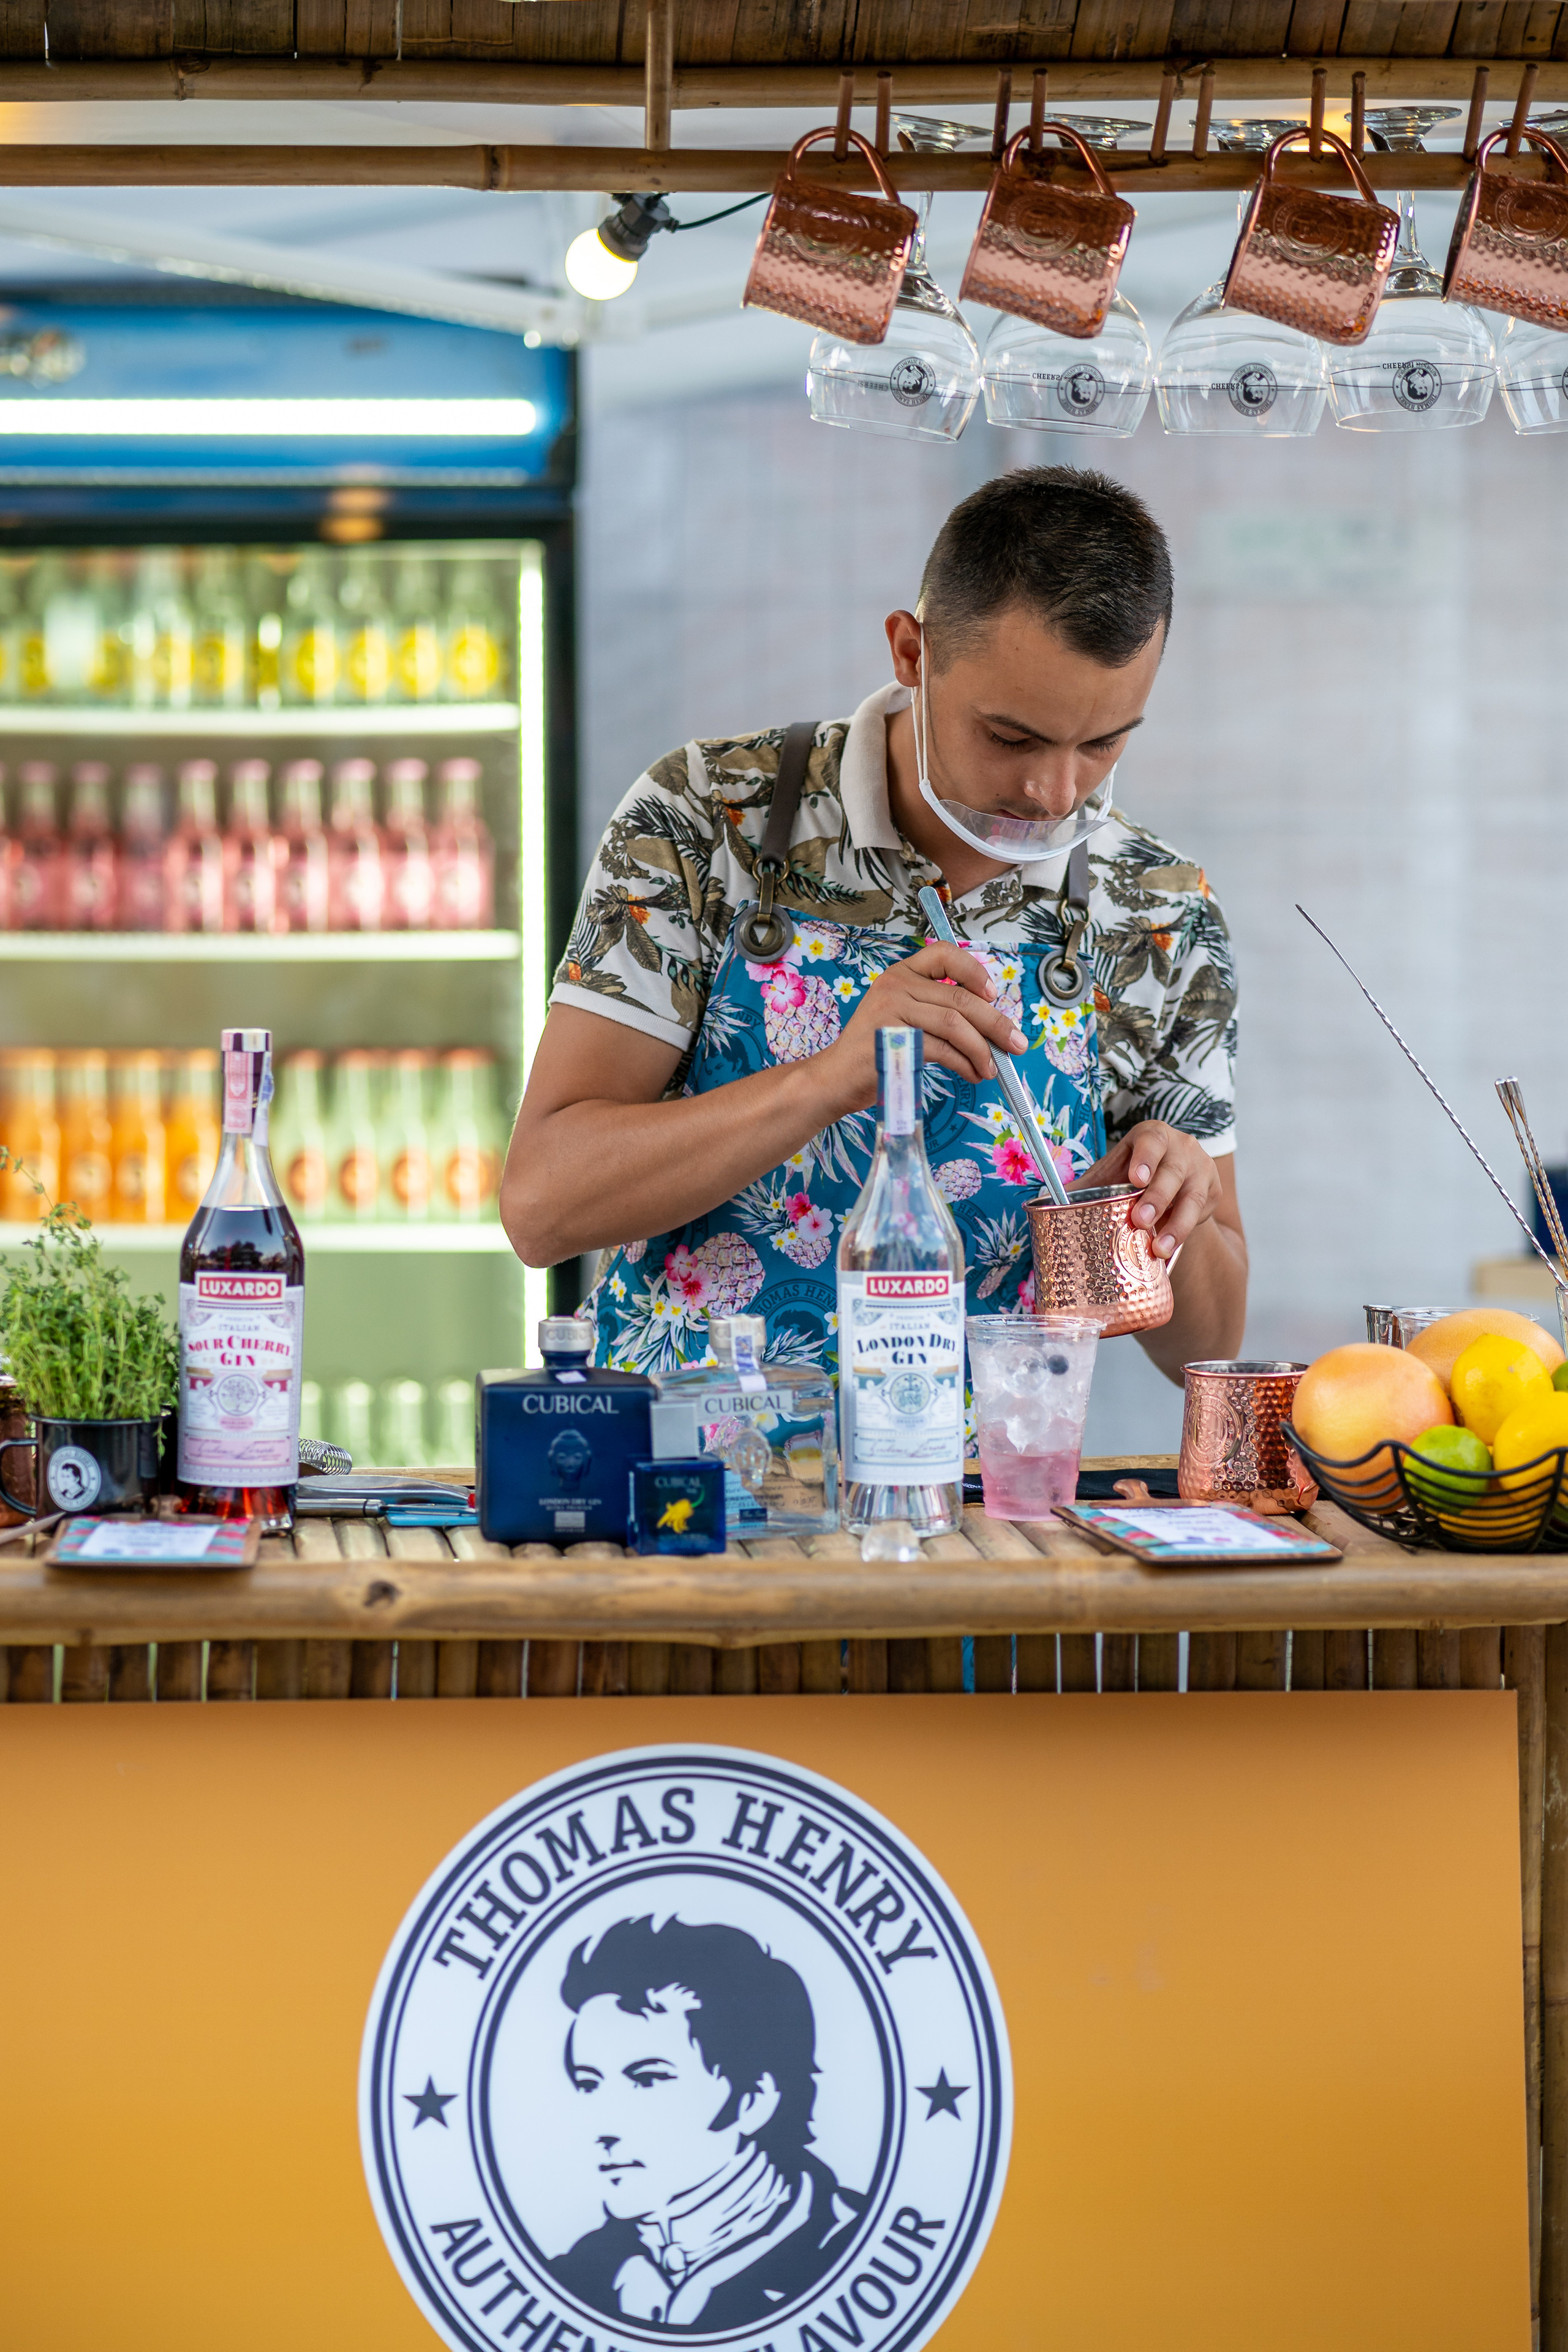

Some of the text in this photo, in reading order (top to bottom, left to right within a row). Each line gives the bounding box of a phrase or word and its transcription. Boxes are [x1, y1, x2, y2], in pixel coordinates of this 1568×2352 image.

[1077, 401, 1099, 415] THOMAS
[1251, 400, 1272, 415] THOMAS
[1398, 394, 1437, 410] THOMAS HENRY
[729, 1009, 761, 1031] ENRY
[954, 1072, 971, 1109] ENRY
[202, 1280, 279, 1297] LUXARDO
[870, 1278, 946, 1294] LUXARDO
[754, 1284, 799, 1316] HOMAS
[857, 1336, 925, 1354] LONDON
[220, 1352, 256, 1366] GIN
[892, 1351, 927, 1365] GIN
[522, 1393, 620, 1414] CUBICAL
[704, 1394, 787, 1414] CUBICAL
[433, 1787, 939, 1981] THOMAS HENRY
